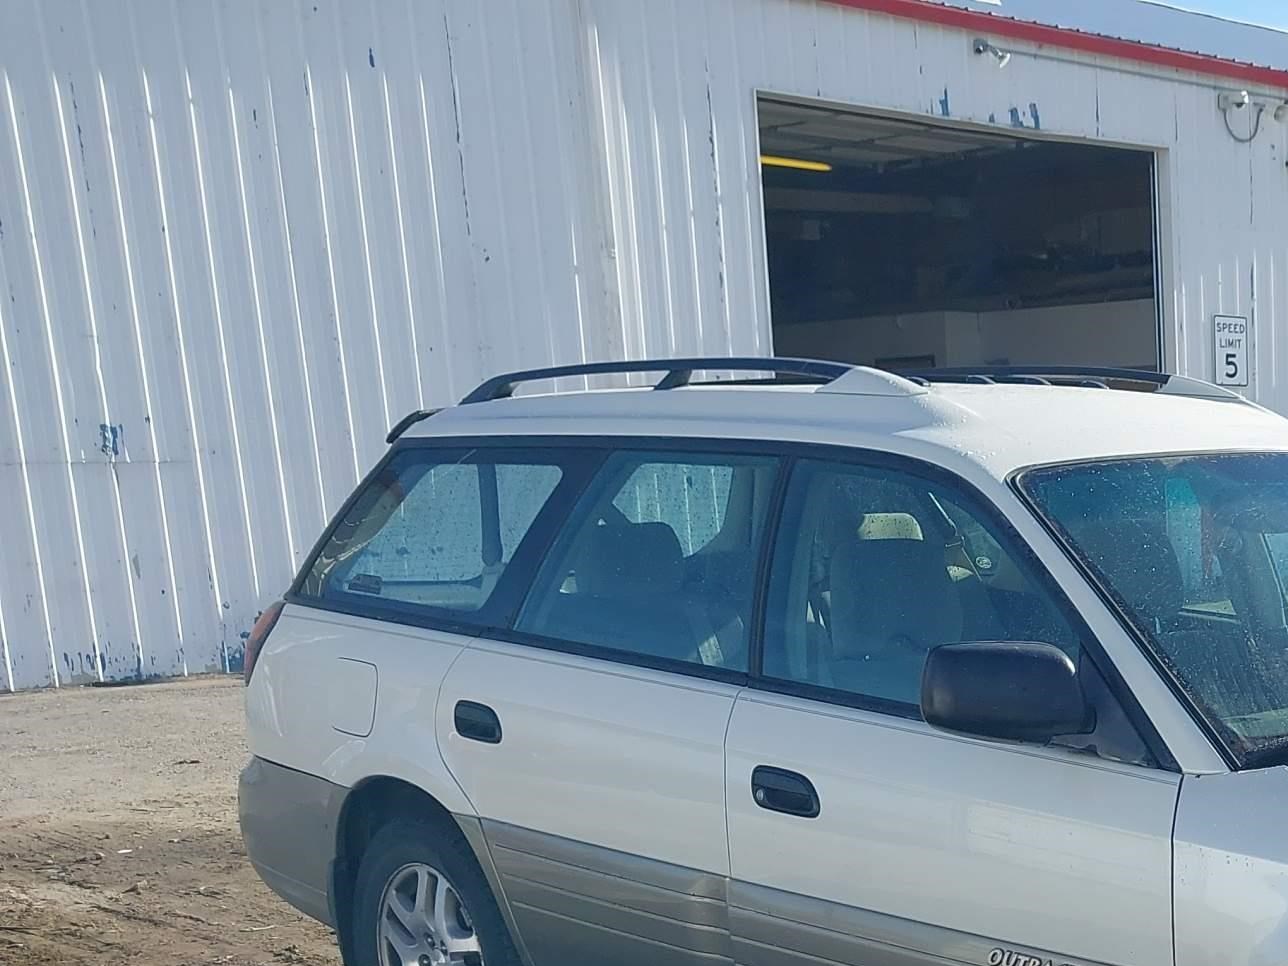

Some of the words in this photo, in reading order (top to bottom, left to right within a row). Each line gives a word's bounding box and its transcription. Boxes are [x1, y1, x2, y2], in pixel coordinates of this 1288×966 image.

[1216, 322, 1246, 334] SPEED
[1219, 338, 1242, 349] LIMIT
[1225, 353, 1238, 378] 5
